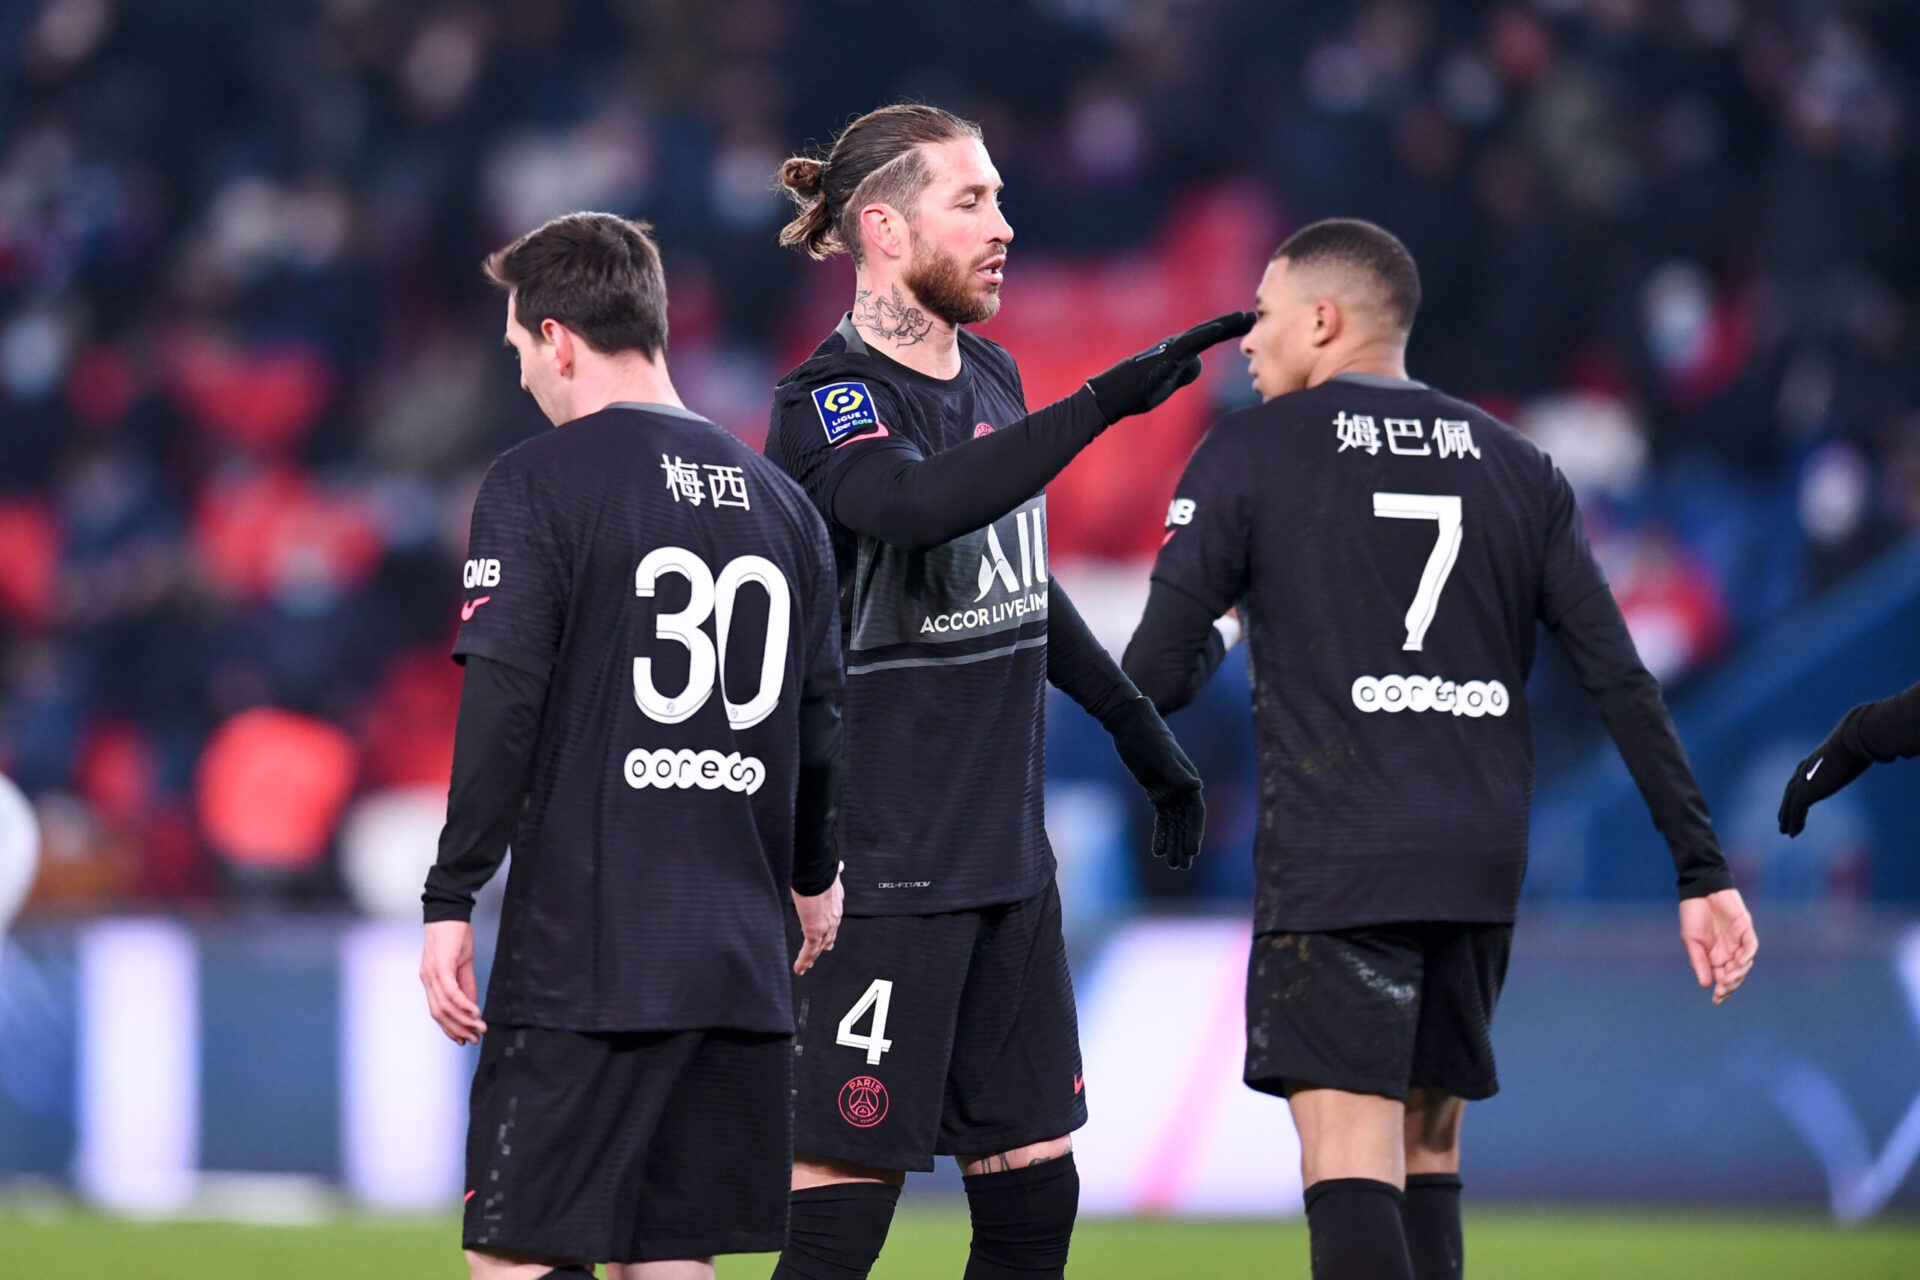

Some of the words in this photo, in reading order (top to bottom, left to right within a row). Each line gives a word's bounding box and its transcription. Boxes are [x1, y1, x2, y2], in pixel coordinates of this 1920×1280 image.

[832, 411, 861, 426] LIGUE
[832, 422, 851, 434] Uber
[852, 418, 873, 426] Eats
[1332, 410, 1481, 460] 姆巴佩
[660, 453, 750, 511] 梅西
[463, 558, 500, 589] QNB
[1373, 492, 1463, 652] 7
[633, 546, 791, 731] 30
[920, 608, 990, 633] ACCOR
[836, 979, 893, 1065] 4
[849, 1079, 881, 1093] PARIS
